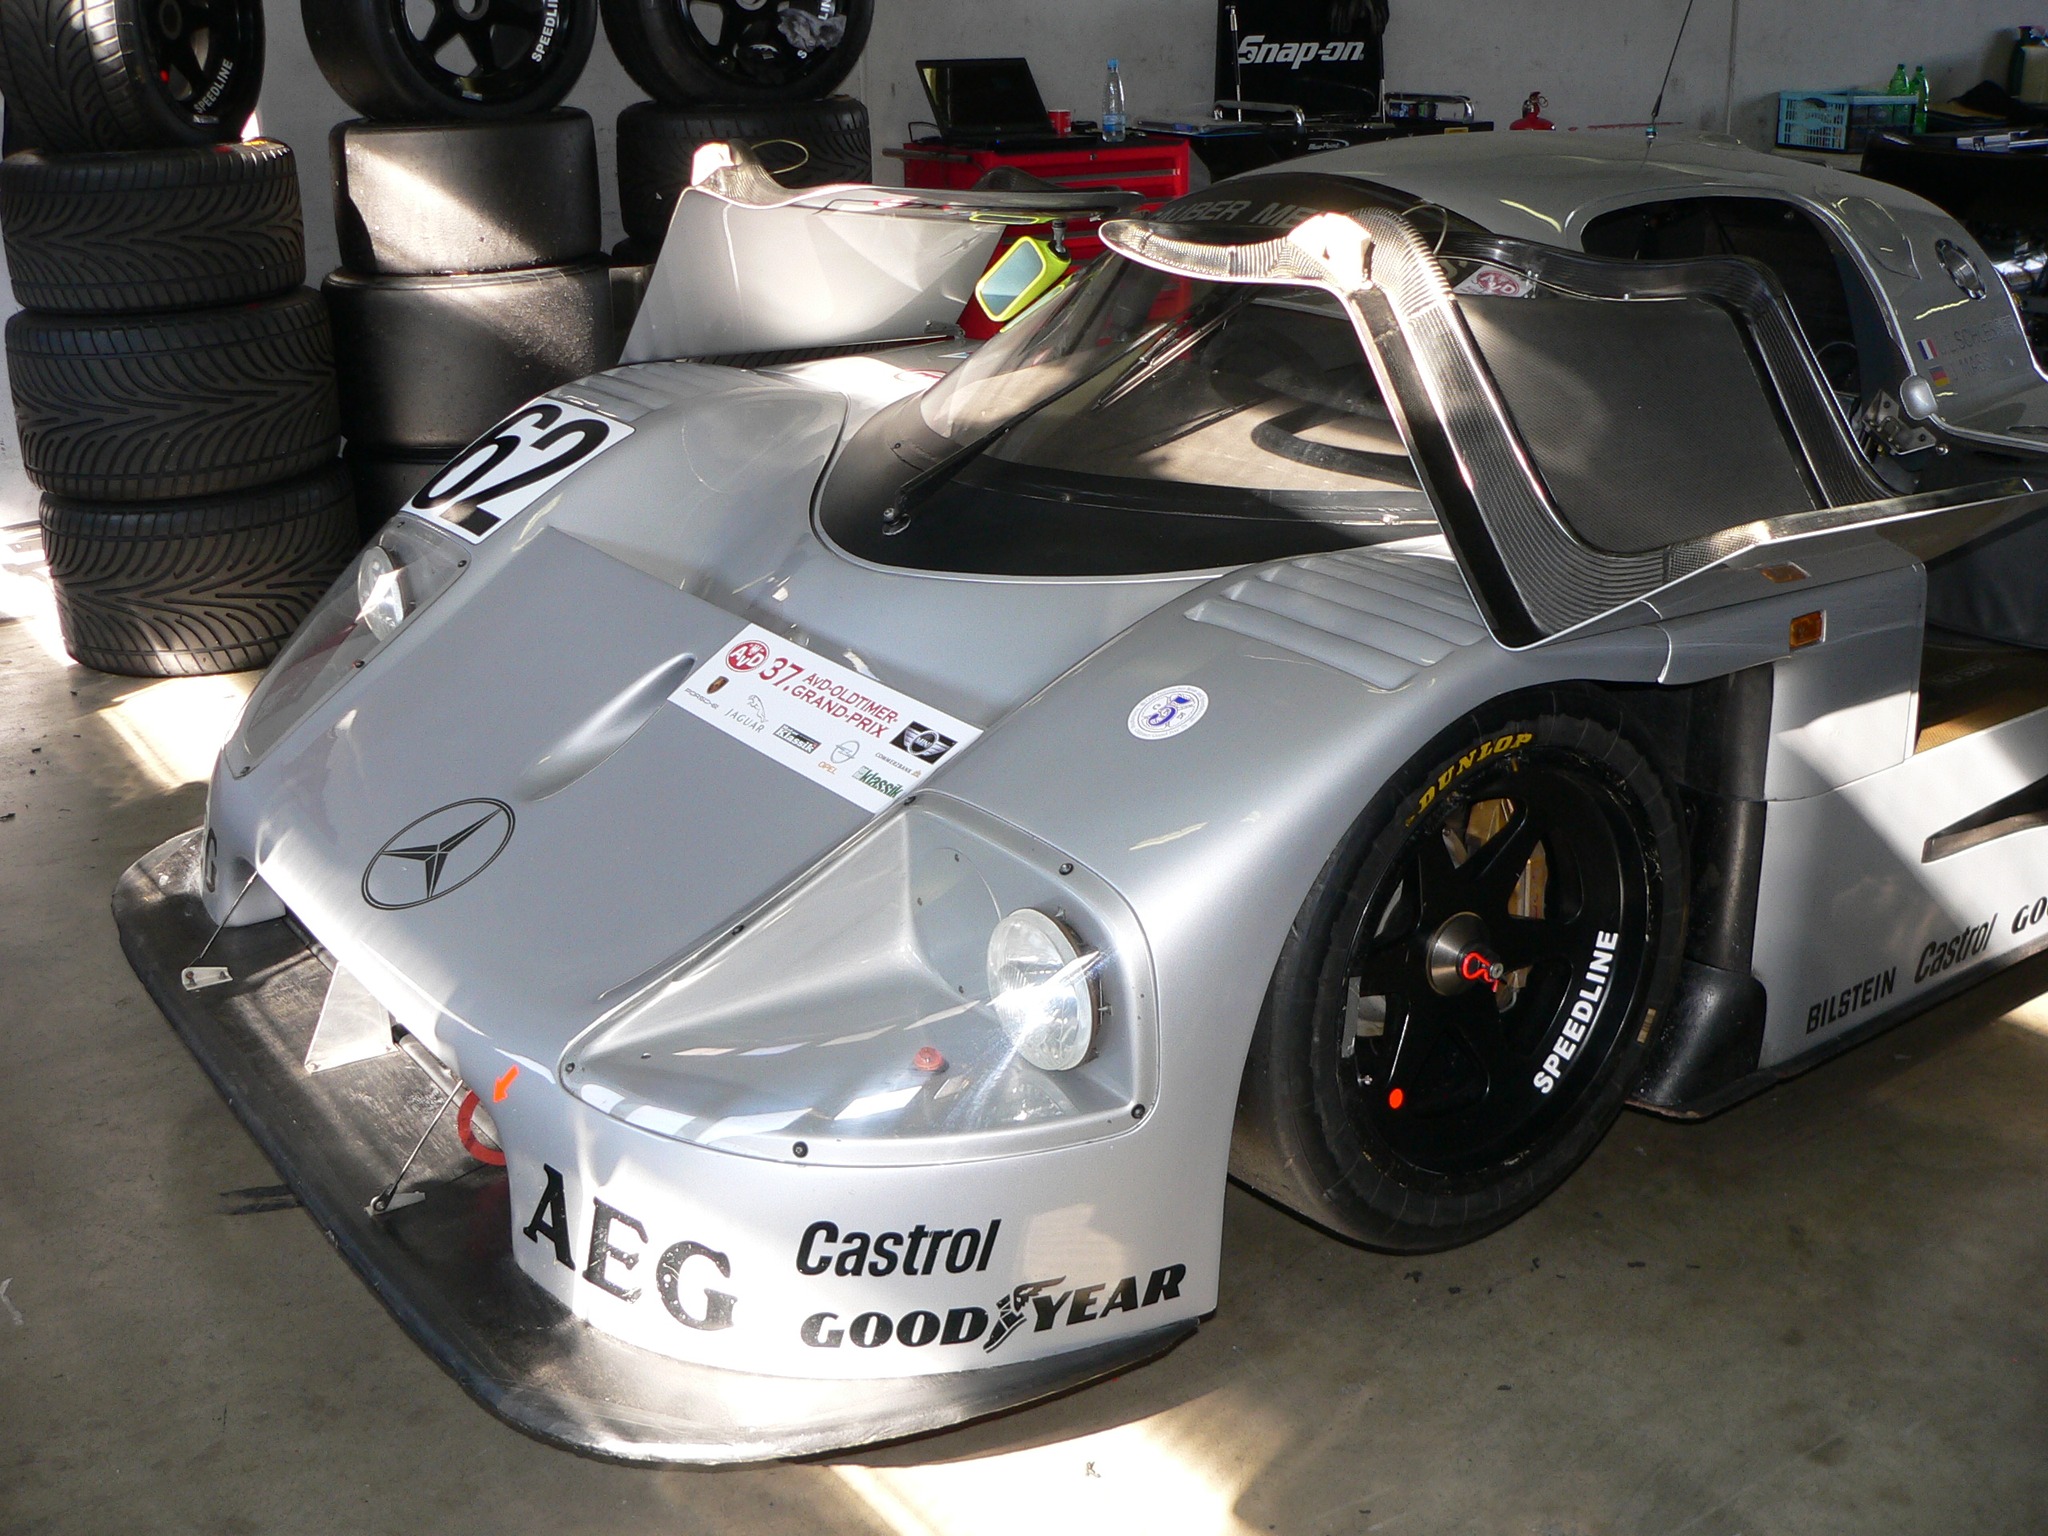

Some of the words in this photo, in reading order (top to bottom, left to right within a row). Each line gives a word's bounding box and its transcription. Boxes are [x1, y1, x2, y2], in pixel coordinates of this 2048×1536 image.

[531, 0, 559, 63] SPEEDLI
[1238, 34, 1364, 70] Snap-on
[193, 58, 234, 114] SPEEDLINE
[411, 403, 611, 538] 62
[725, 708, 765, 733] JAGUAR
[791, 685, 889, 738] GRAND-PRIX
[818, 761, 837, 775] OPEL
[1418, 733, 1533, 814] DUNLOP
[1806, 966, 1897, 1035] BILSTEIN
[1914, 912, 1999, 984] Castrol
[2011, 896, 2048, 934] GO
[1533, 930, 1639, 1094] SPEEDLINE
[523, 1163, 739, 1332] AEG
[796, 1218, 1002, 1277] Castrol
